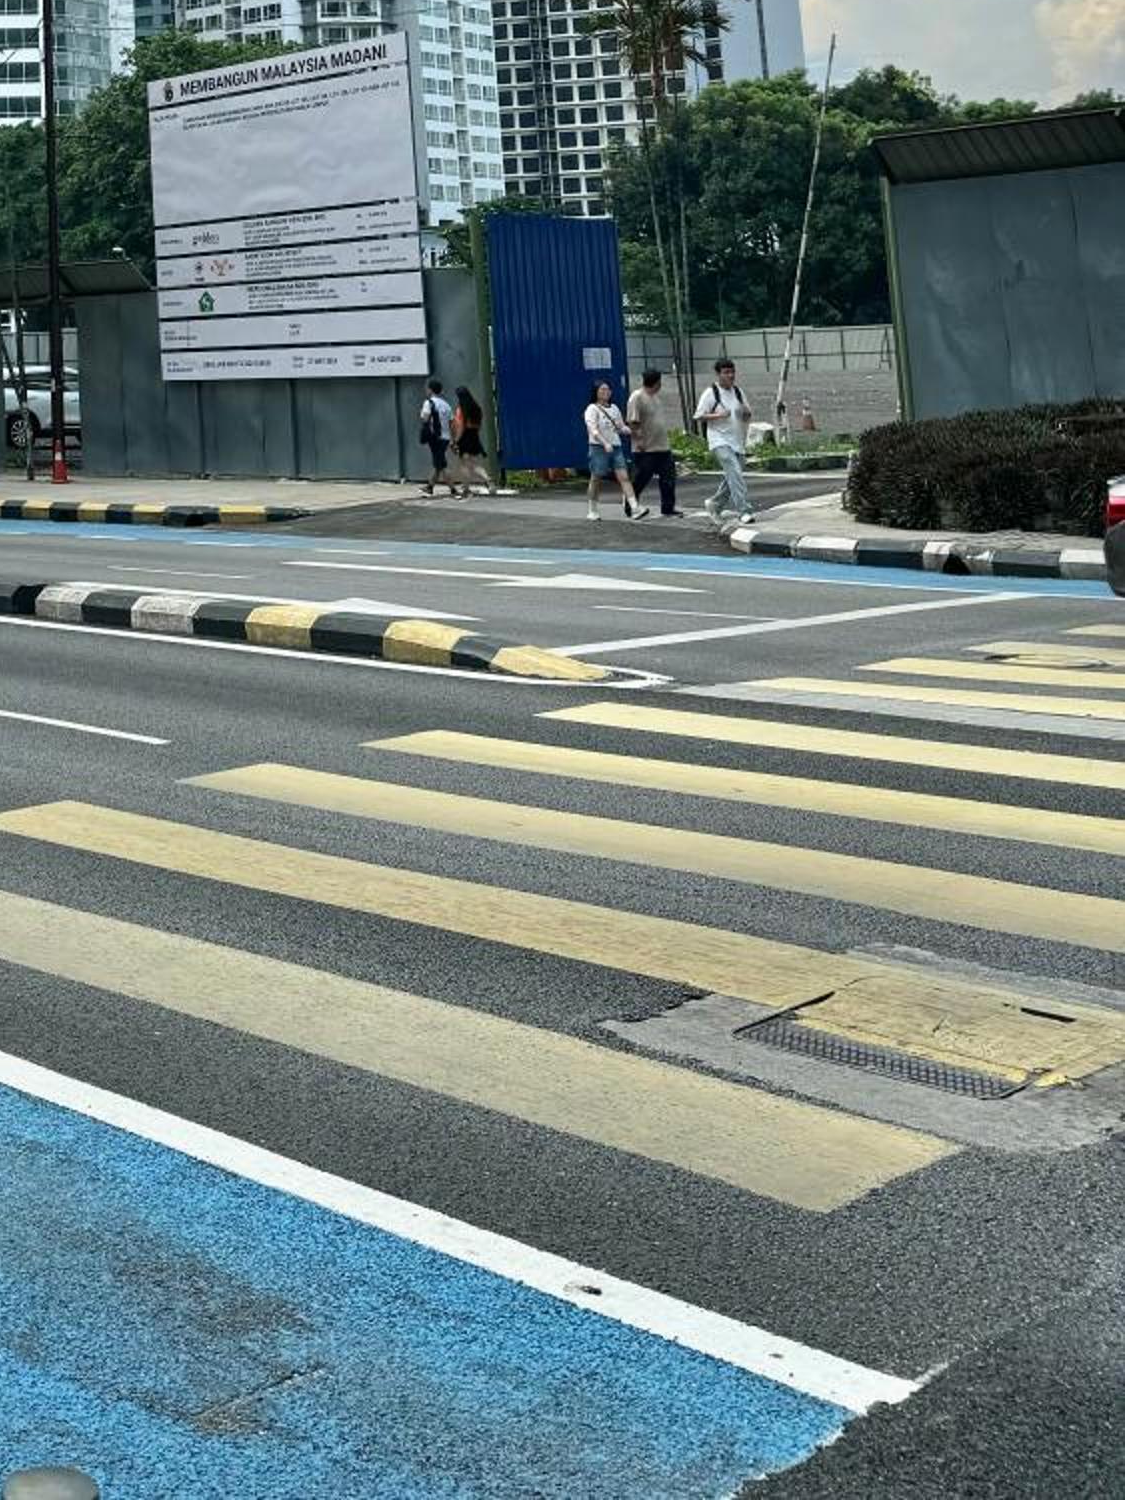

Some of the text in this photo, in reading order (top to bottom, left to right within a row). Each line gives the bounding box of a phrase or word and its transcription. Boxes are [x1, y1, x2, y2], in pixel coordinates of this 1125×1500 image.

[180, 43, 387, 96] MEMBANGUN MALAYSIA MADANI
